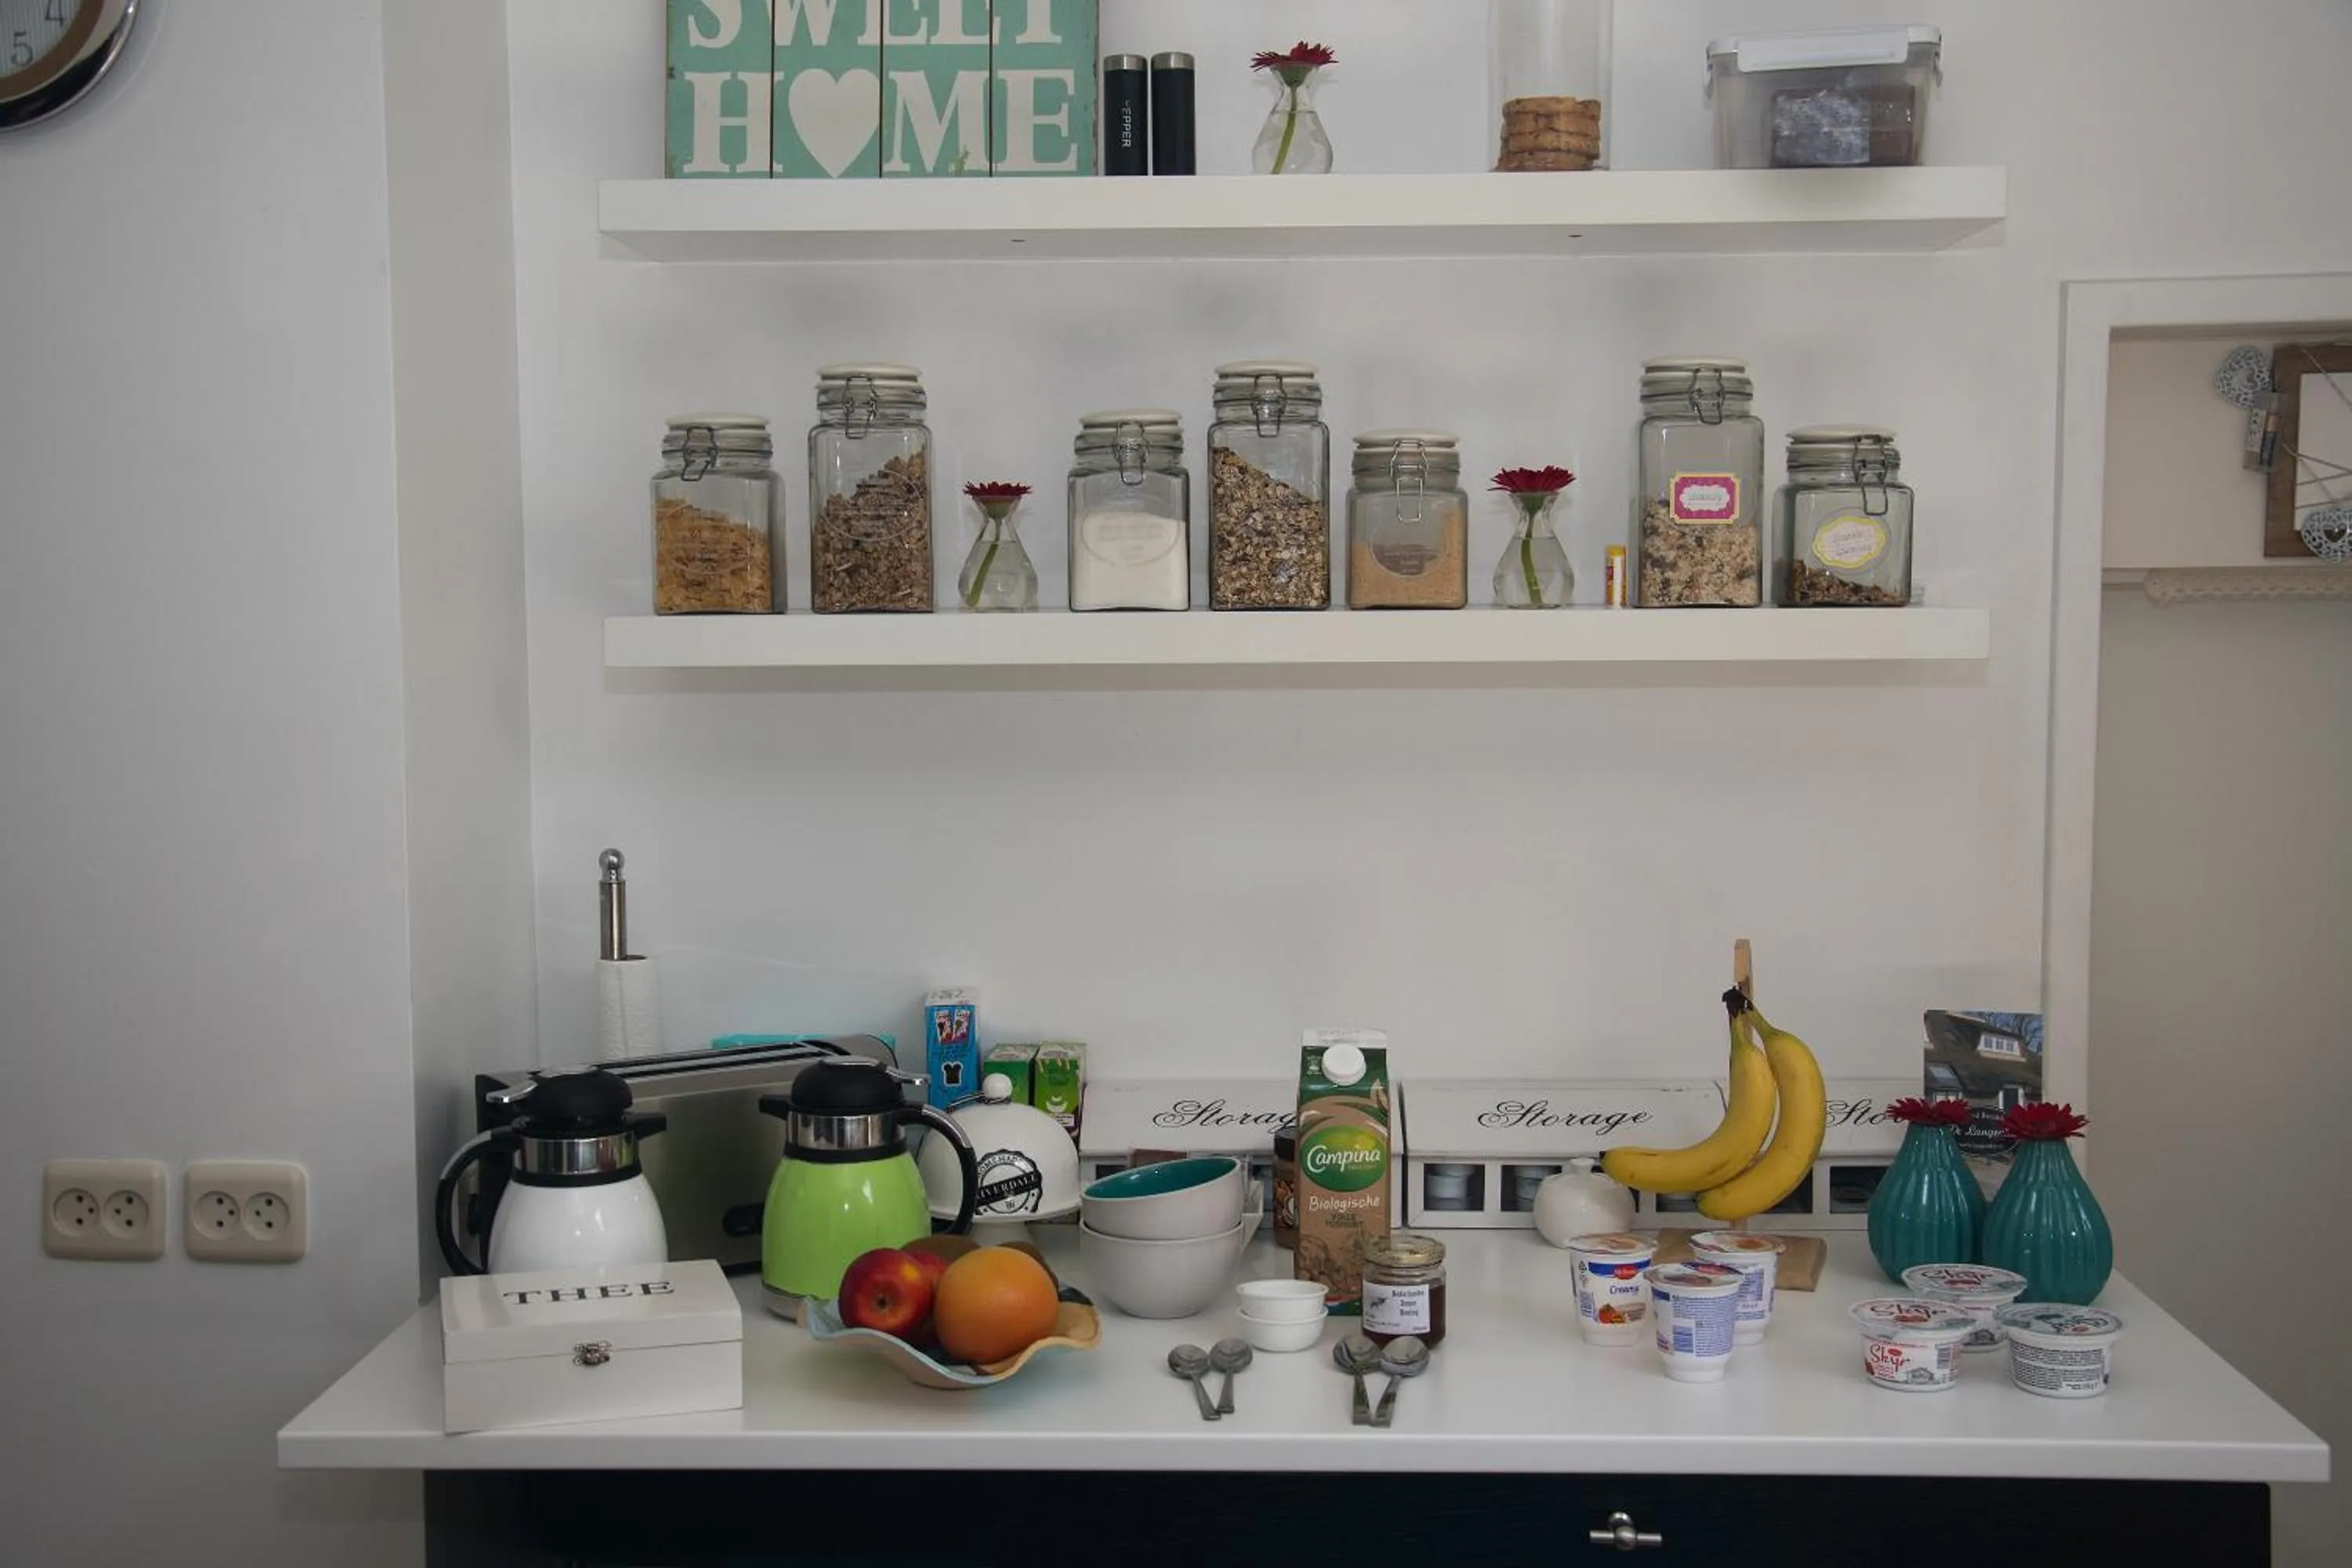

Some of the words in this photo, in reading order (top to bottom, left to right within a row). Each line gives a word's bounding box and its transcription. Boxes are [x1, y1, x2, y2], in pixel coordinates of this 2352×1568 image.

[11, 31, 34, 67] 5
[1152, 1099, 1297, 1134] Storag
[1478, 1100, 1653, 1135] Storage
[1307, 1145, 1381, 1174] Campina
[1309, 1193, 1380, 1213] Biologische
[503, 1280, 675, 1305] THEE
[1870, 1343, 1911, 1372] Skyr
